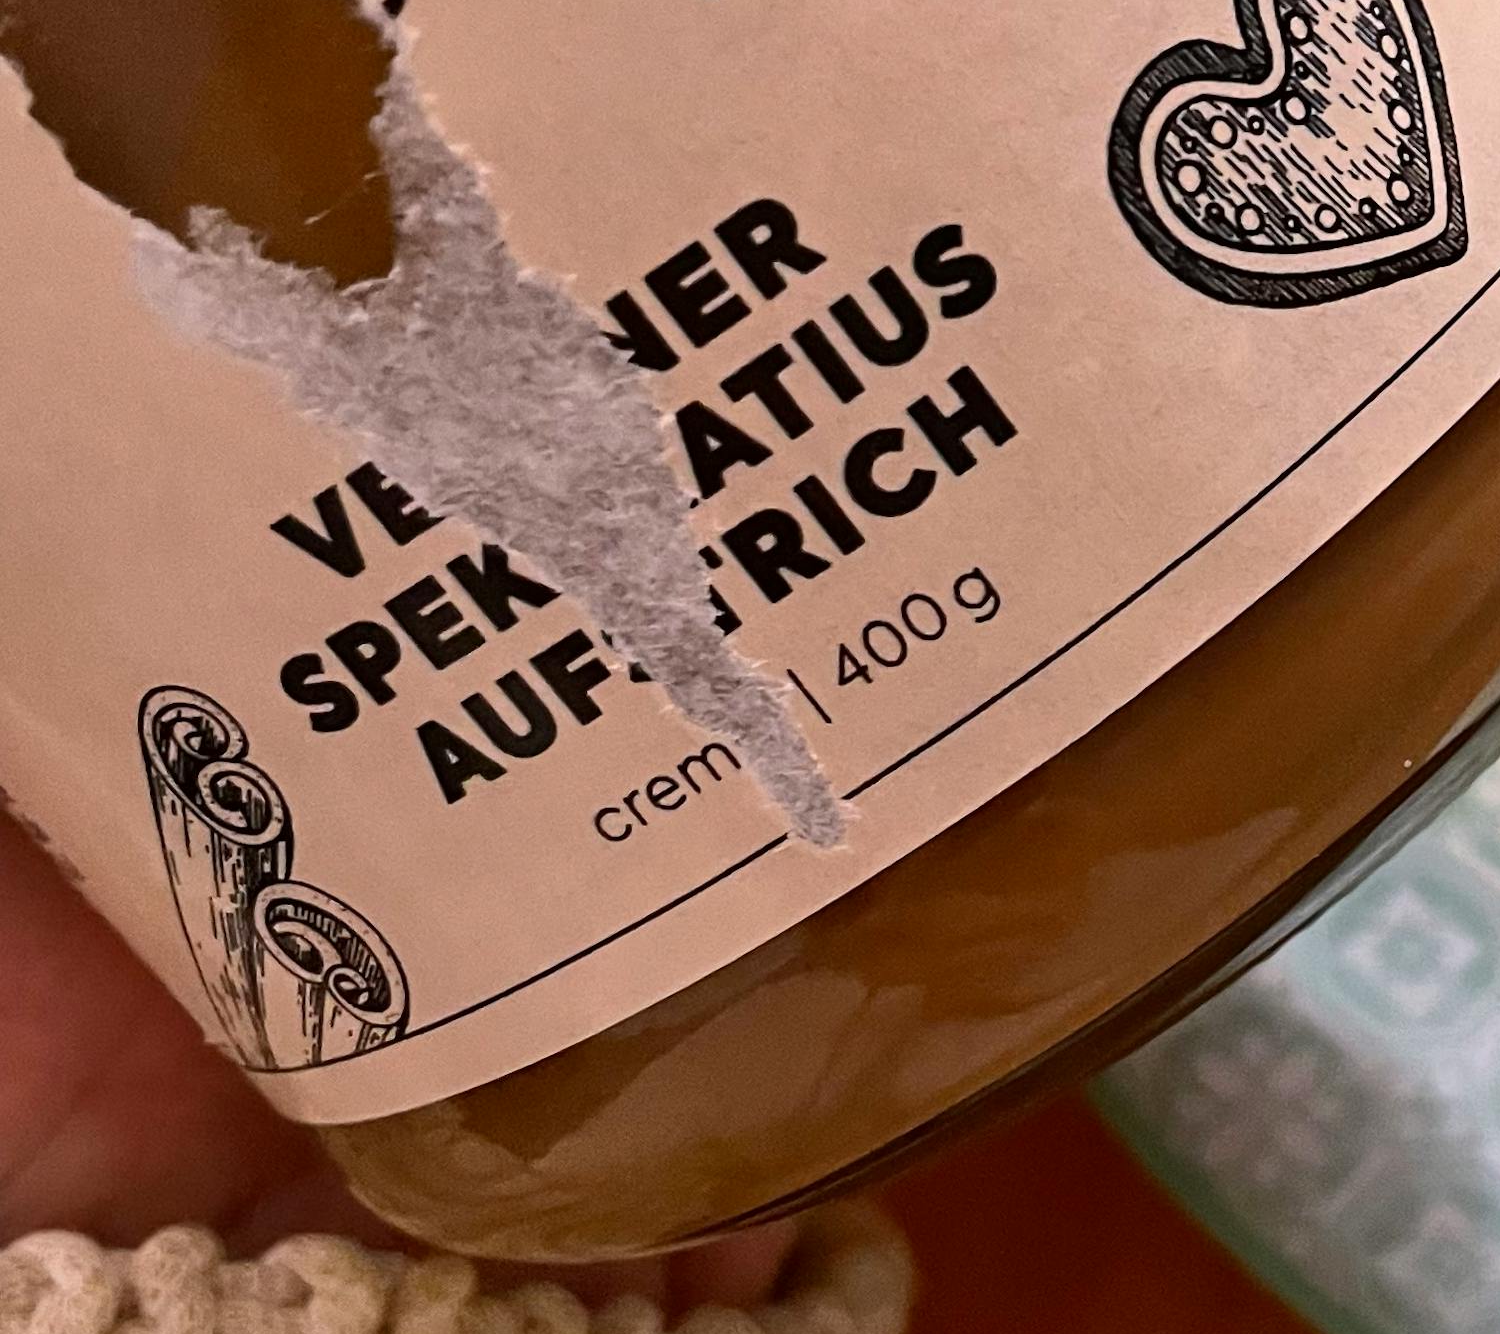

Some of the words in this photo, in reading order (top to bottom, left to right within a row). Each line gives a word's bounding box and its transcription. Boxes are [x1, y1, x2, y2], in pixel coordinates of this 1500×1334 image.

[269, 198, 828, 578] VENER
[279, 223, 998, 733] SPEKATIUS
[415, 365, 1019, 805] AUFRICH
[593, 742, 743, 843] crem
